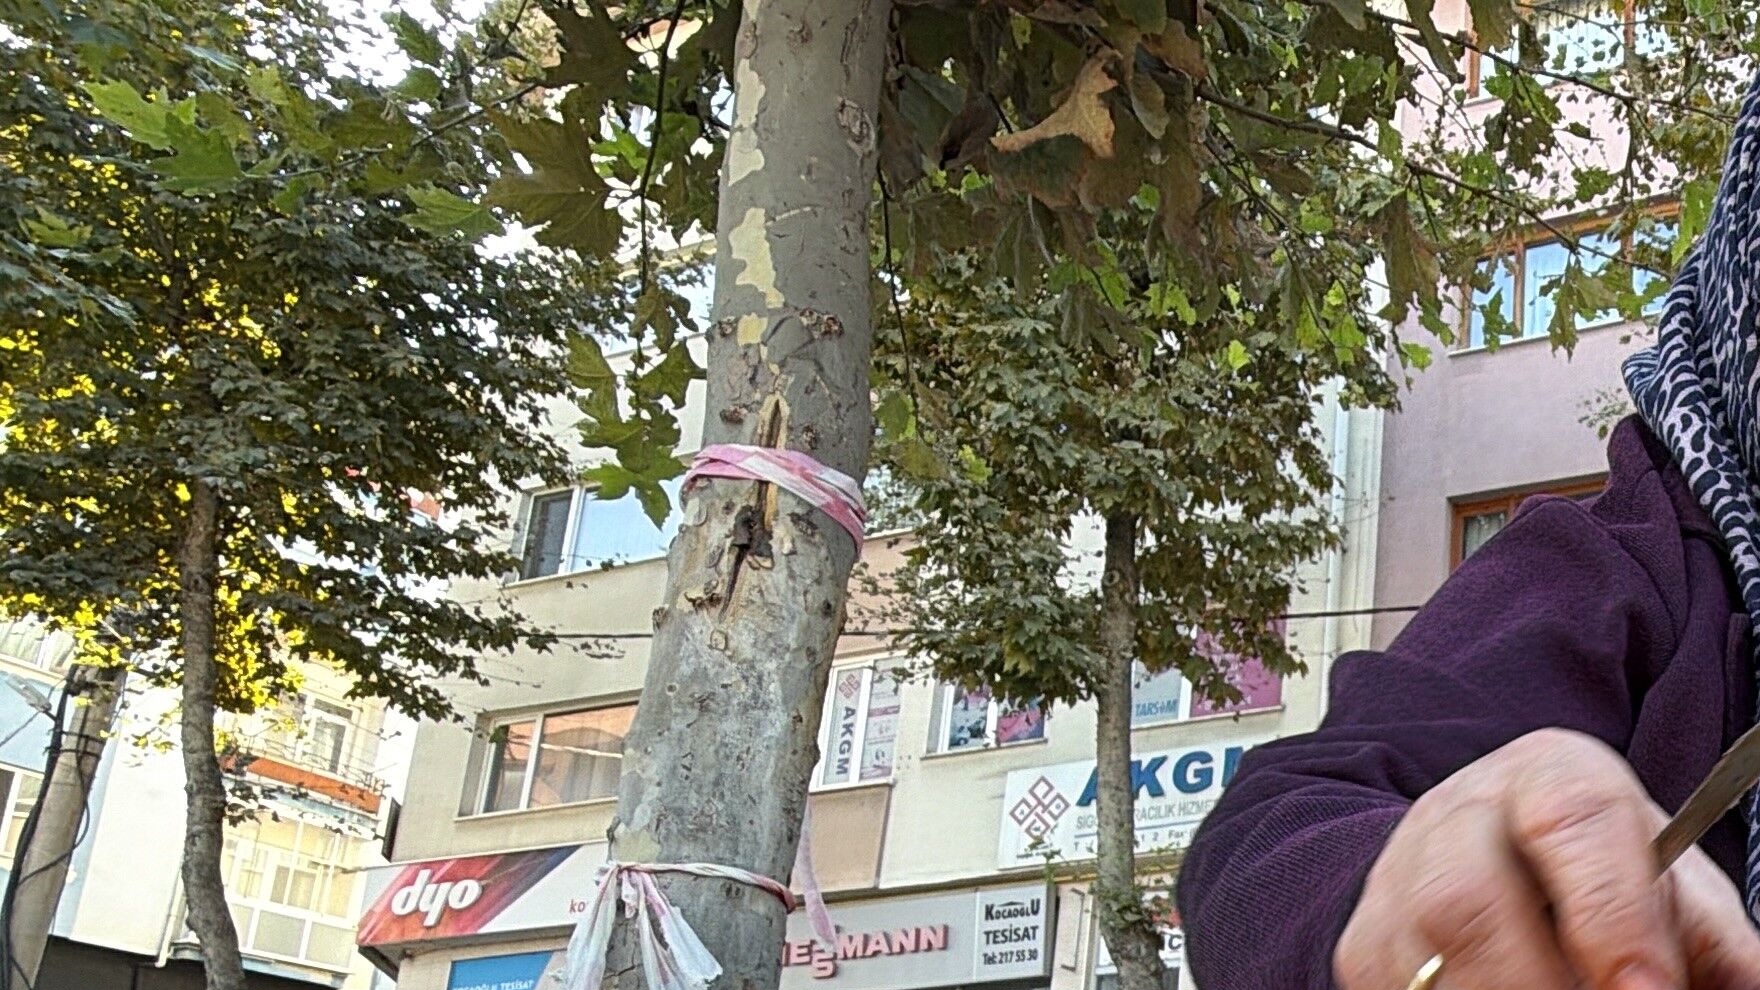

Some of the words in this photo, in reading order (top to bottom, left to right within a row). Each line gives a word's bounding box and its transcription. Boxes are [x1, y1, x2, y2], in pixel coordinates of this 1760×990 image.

[835, 706, 856, 775] AKGM
[391, 869, 482, 927] dyo
[983, 923, 1039, 945] TESİSAT
[999, 951, 1014, 964] 217
[1015, 949, 1026, 963] 55
[1027, 948, 1038, 961] 30
